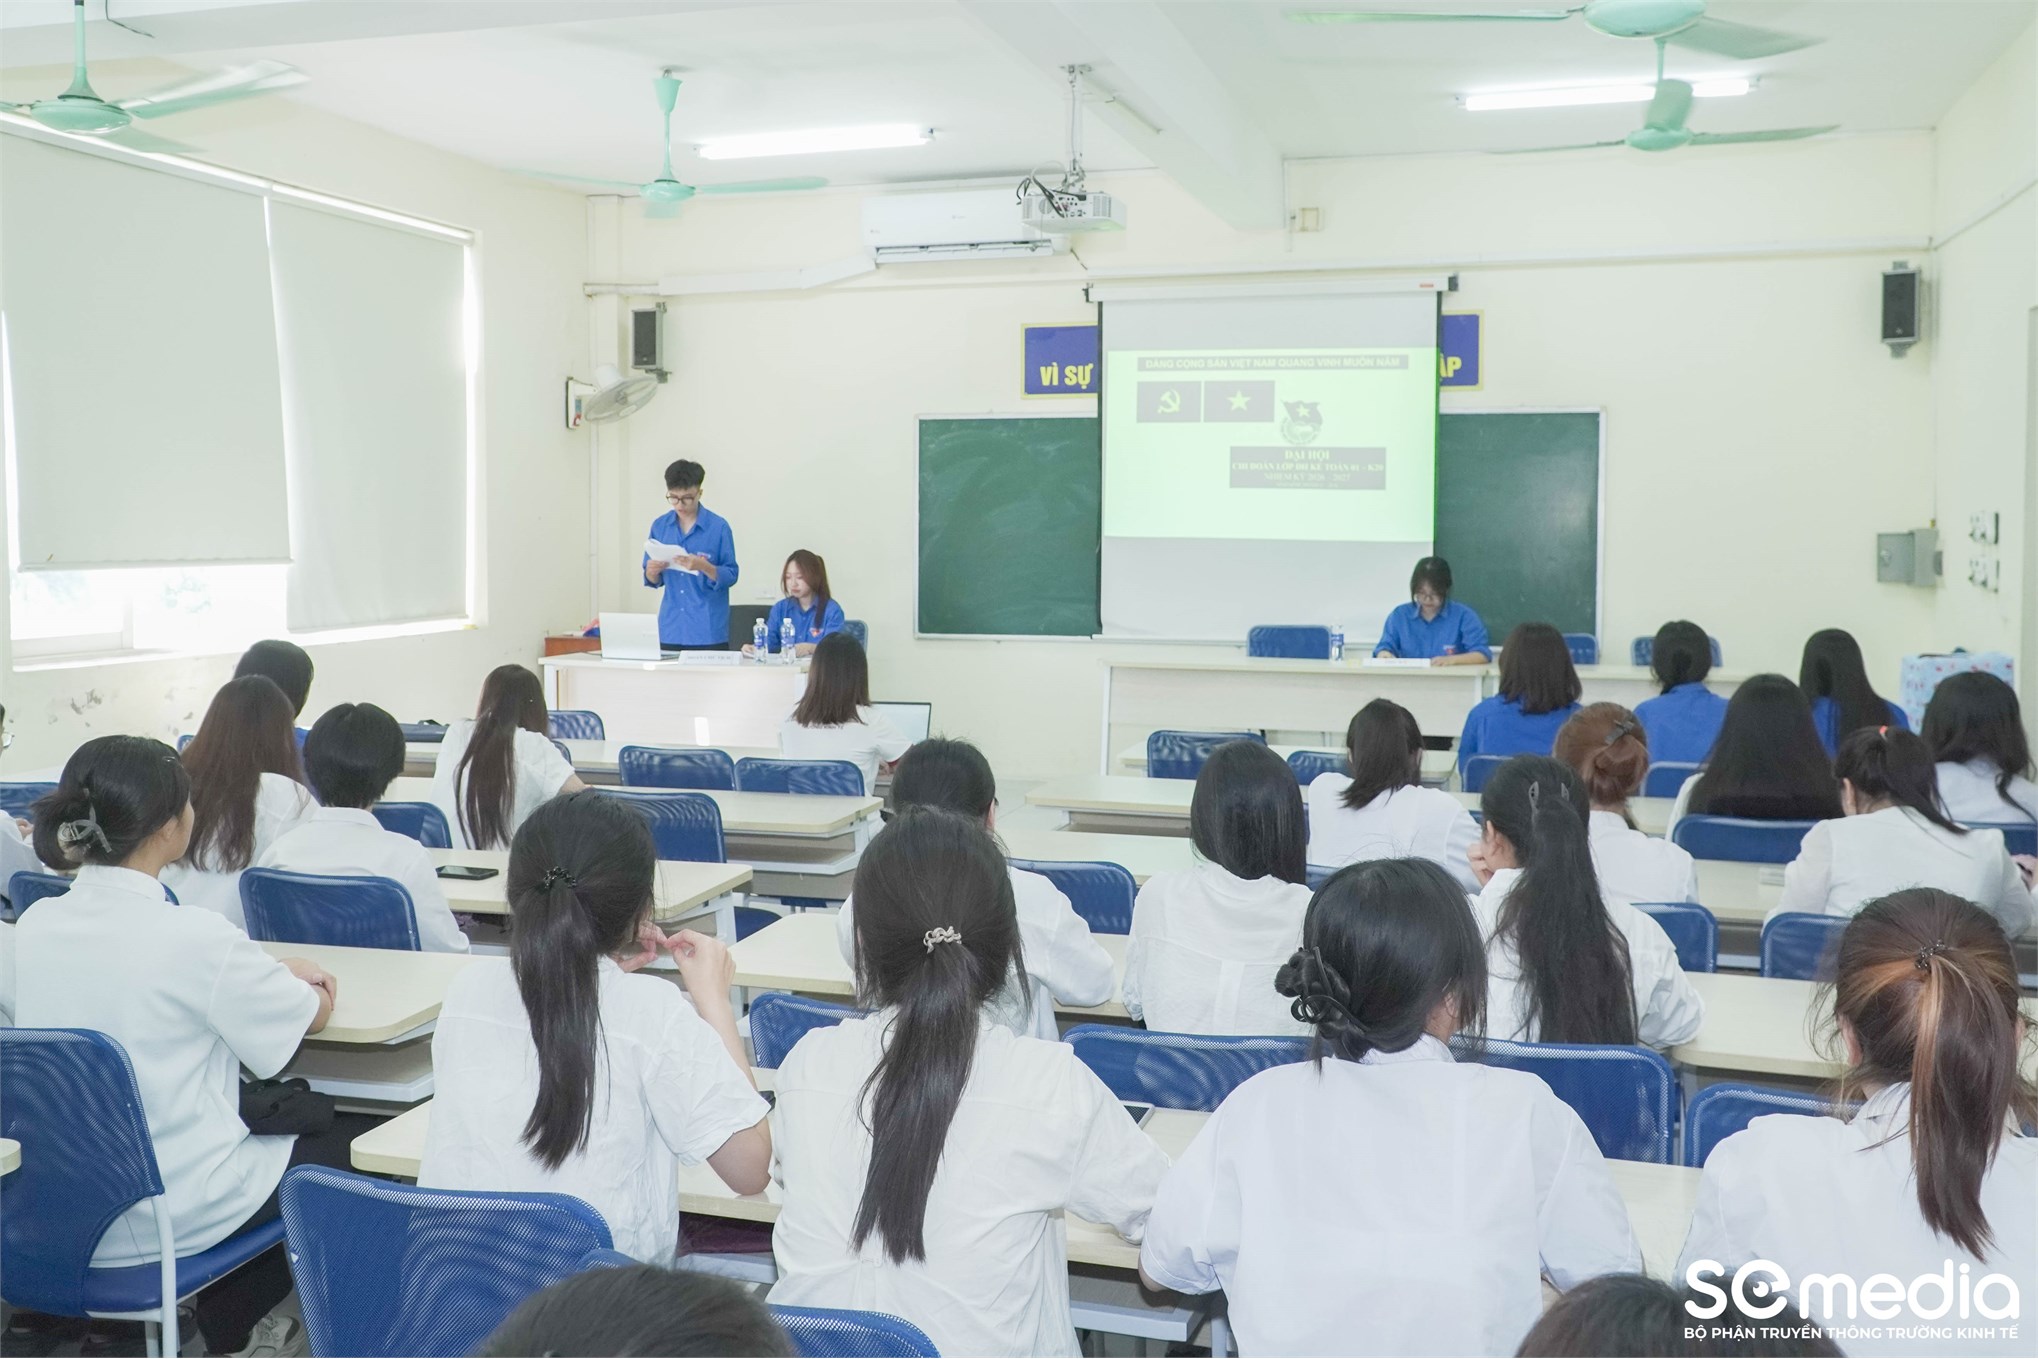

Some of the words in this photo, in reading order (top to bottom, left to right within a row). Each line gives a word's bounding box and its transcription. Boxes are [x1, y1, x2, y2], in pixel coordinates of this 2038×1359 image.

[1176, 358, 1205, 370] CỘNG
[1230, 357, 1252, 369] VIỆT
[1254, 358, 1276, 368] NAM
[1278, 358, 1315, 368] QUANG
[1317, 358, 1342, 367] VINH
[1040, 362, 1059, 386] VÌ
[1064, 363, 1094, 390] SỰ
